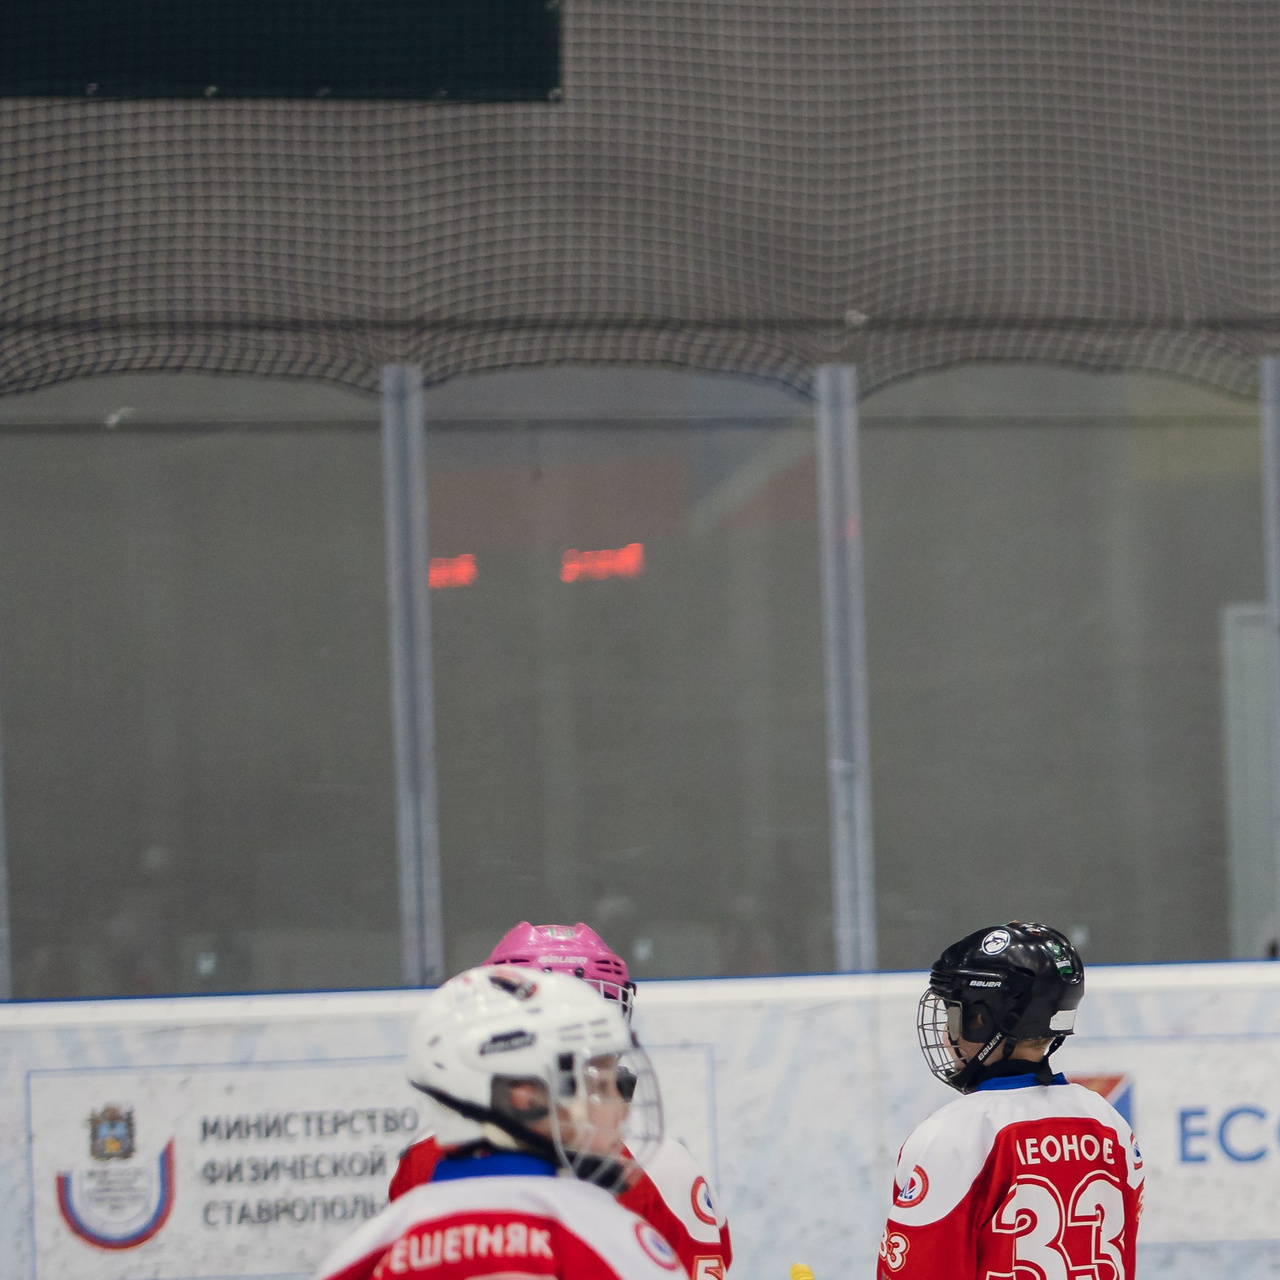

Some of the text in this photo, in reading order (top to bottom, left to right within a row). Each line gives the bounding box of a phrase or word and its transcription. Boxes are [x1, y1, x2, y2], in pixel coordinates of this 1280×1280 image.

[978, 1032, 1002, 1061] BAUER
[201, 1108, 418, 1141] МИНИСТЕРСТВО
[202, 1146, 386, 1183] ФИЗИЧЕСКОЙ
[373, 1222, 554, 1280] ЕШЕТНЯК
